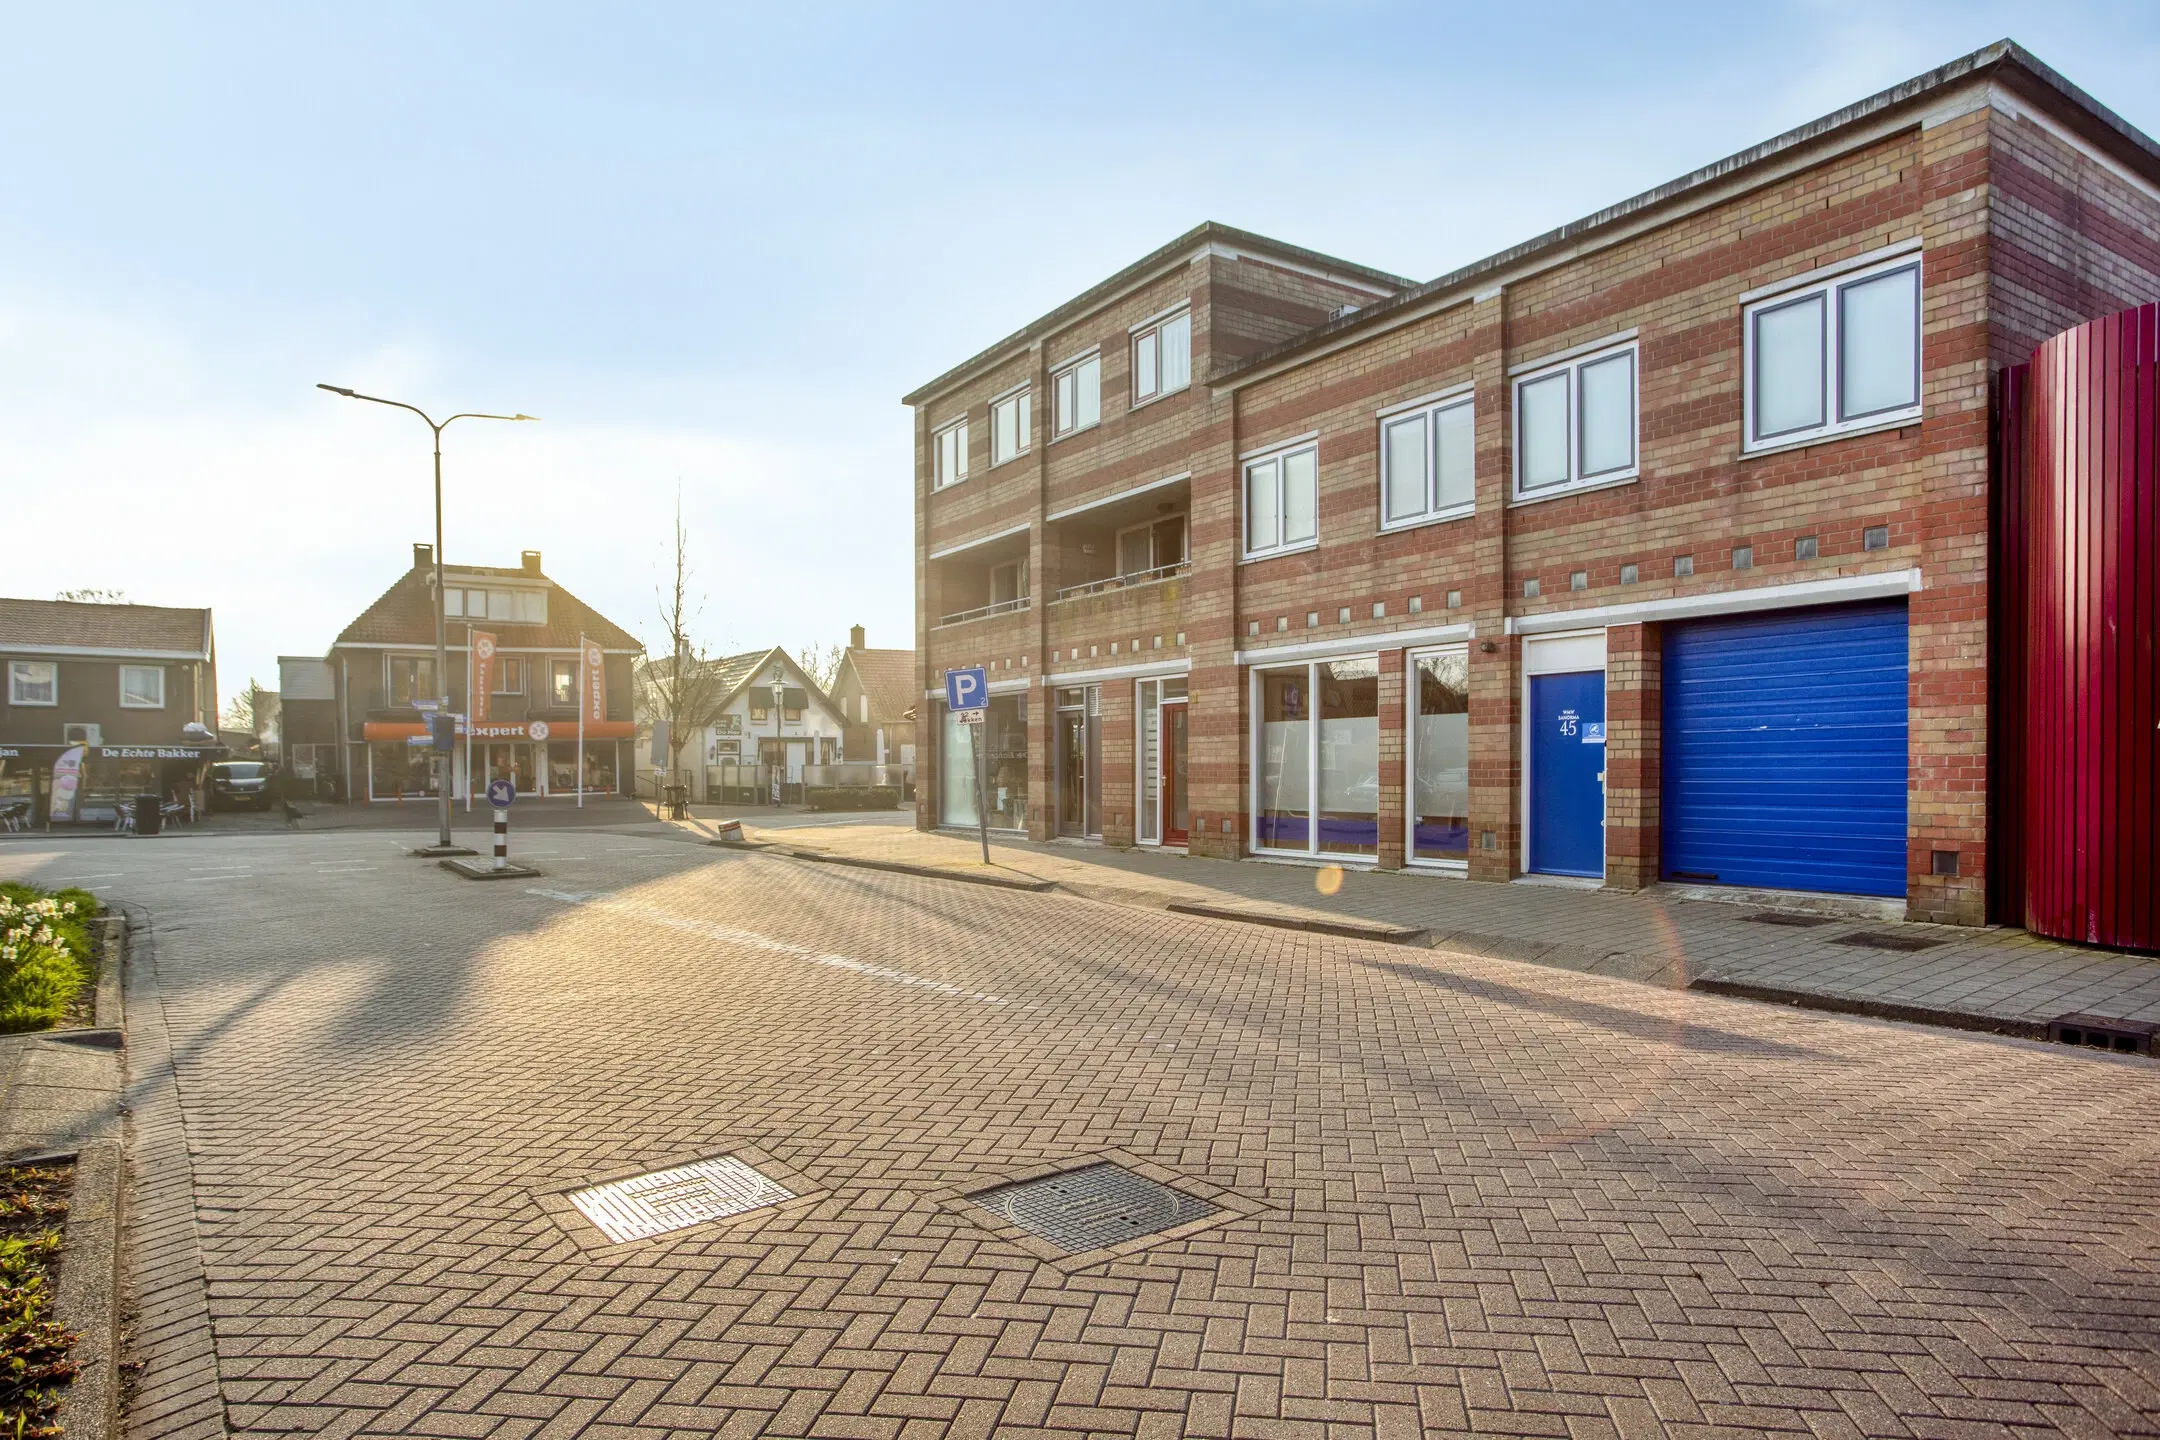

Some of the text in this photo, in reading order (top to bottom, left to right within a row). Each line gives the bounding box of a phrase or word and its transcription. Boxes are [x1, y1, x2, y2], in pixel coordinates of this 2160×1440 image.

[955, 674, 977, 705] P
[980, 697, 987, 706] 2
[468, 726, 524, 737] expert
[1559, 720, 1577, 736] 45
[101, 748, 201, 758] De Echte Bakker
